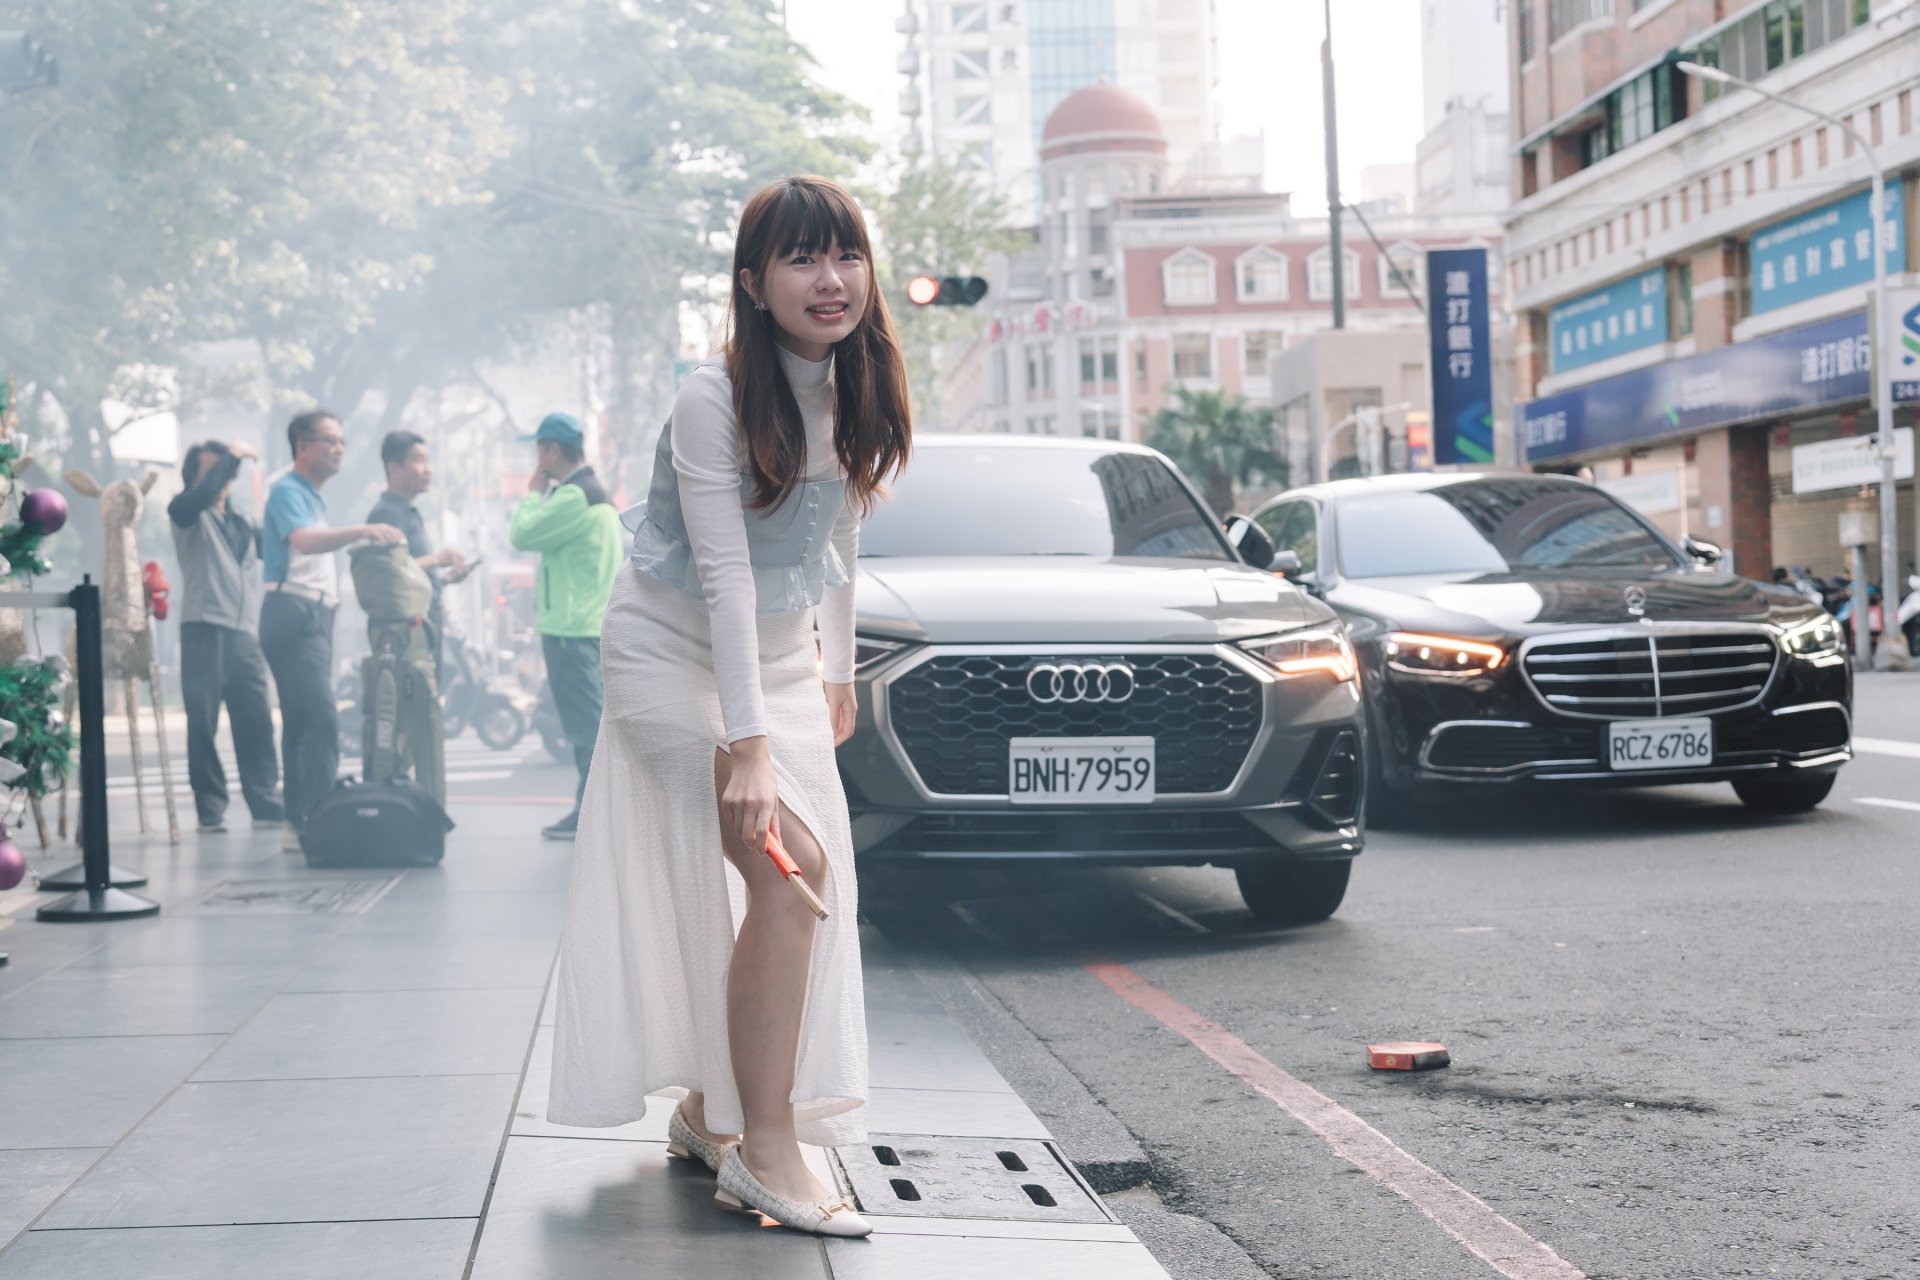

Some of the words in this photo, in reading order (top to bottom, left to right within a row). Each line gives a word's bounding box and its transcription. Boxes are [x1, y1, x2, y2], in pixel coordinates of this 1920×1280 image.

[1445, 269, 1474, 379] 渣打銀行
[1801, 334, 1871, 384] 渣打銀行
